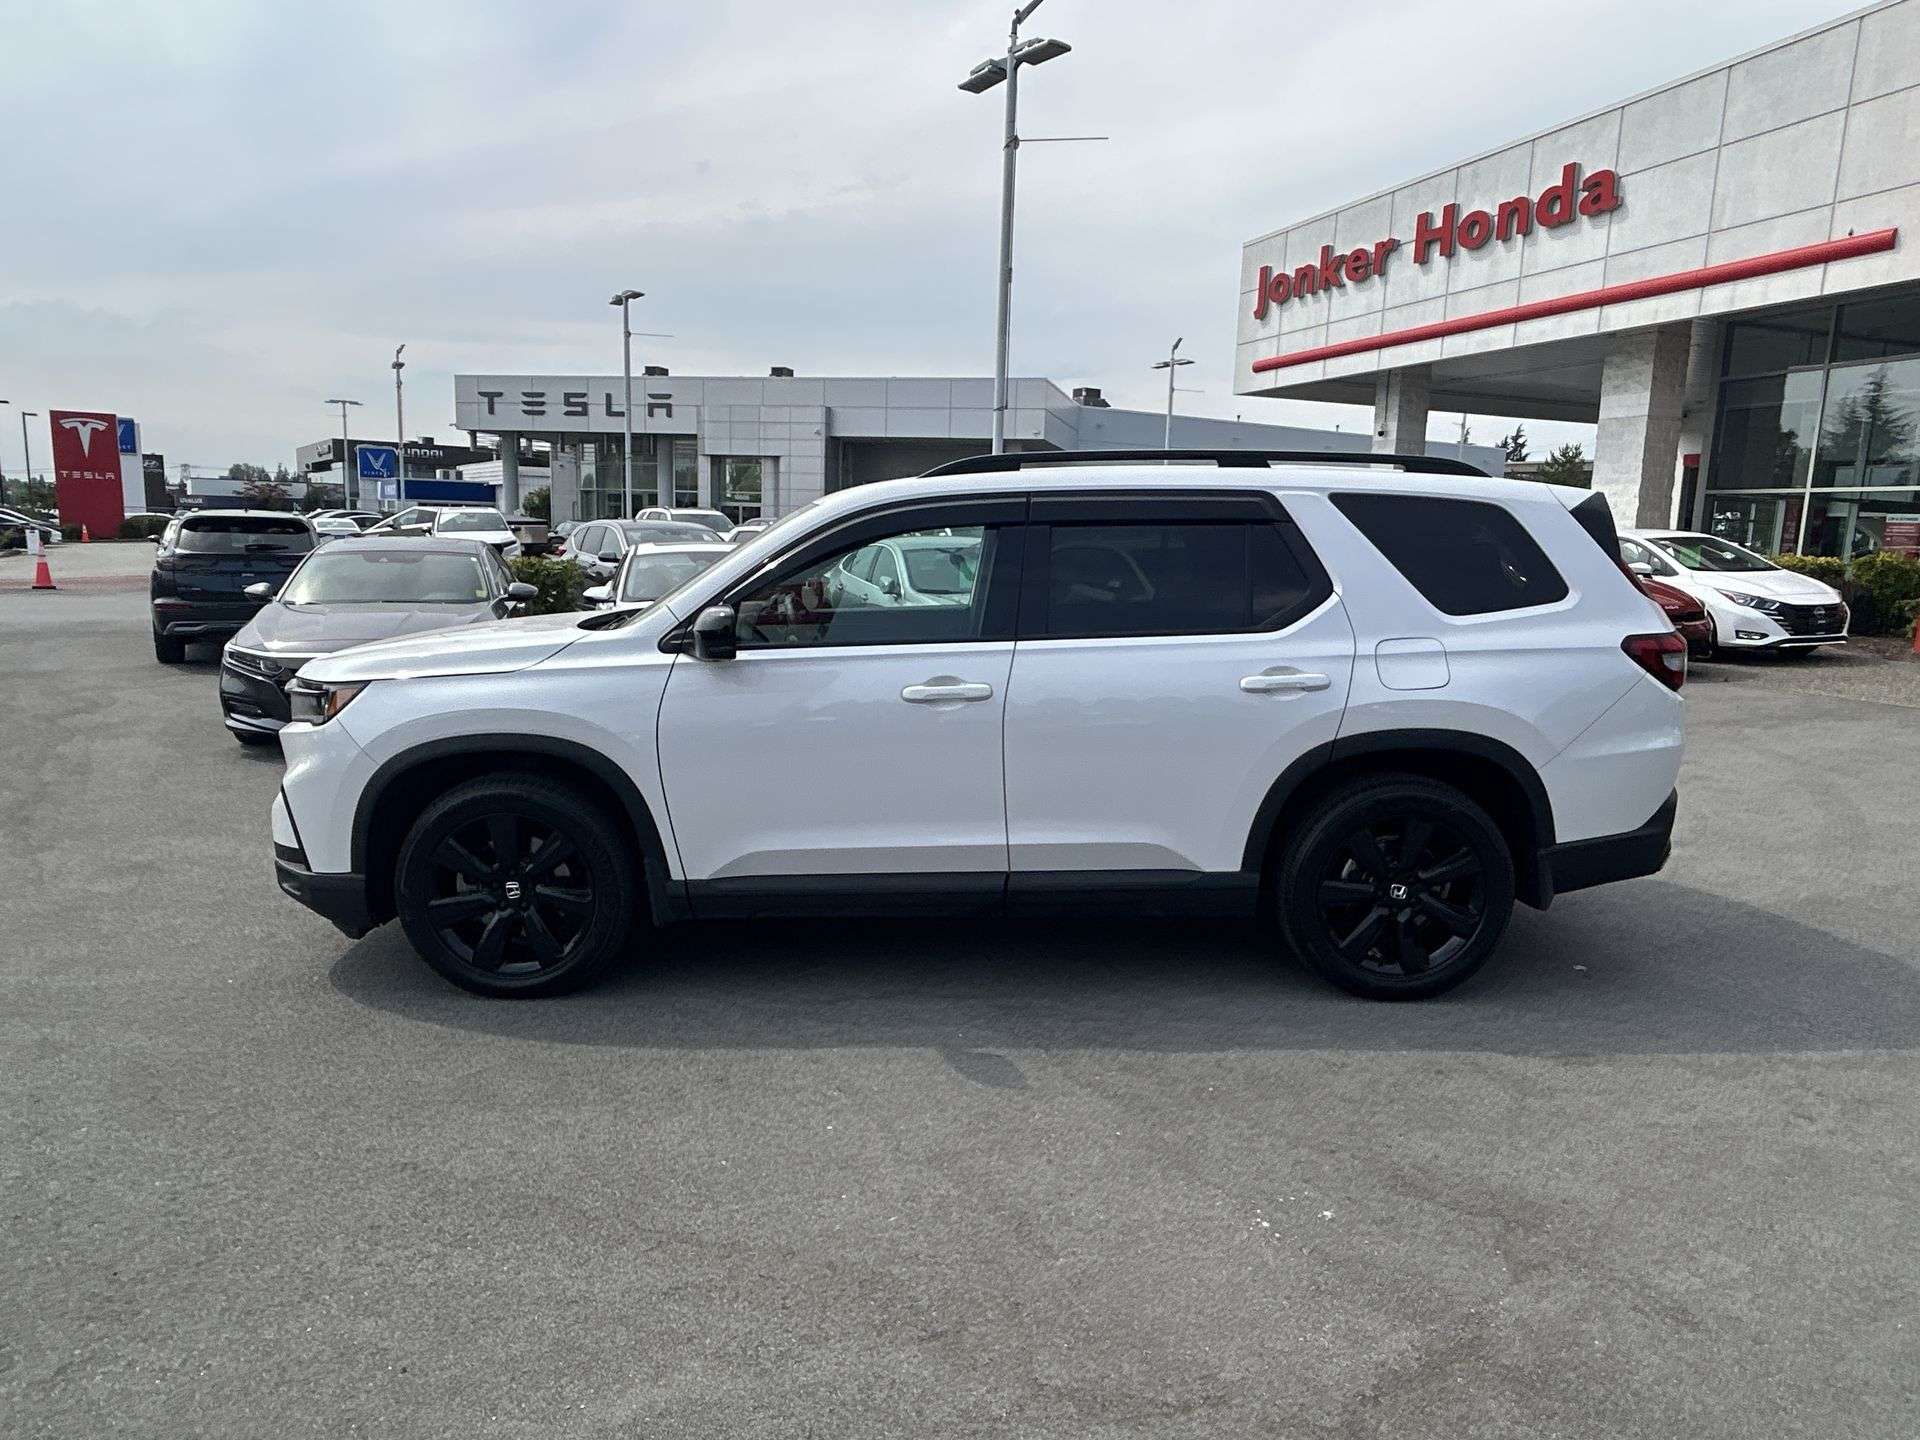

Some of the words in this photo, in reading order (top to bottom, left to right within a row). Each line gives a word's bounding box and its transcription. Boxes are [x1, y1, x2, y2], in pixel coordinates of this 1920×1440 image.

[1254, 238, 1400, 320] Jonker
[1413, 162, 1622, 265] Honda
[478, 391, 673, 418] TESLA
[60, 470, 116, 480] TESLA
